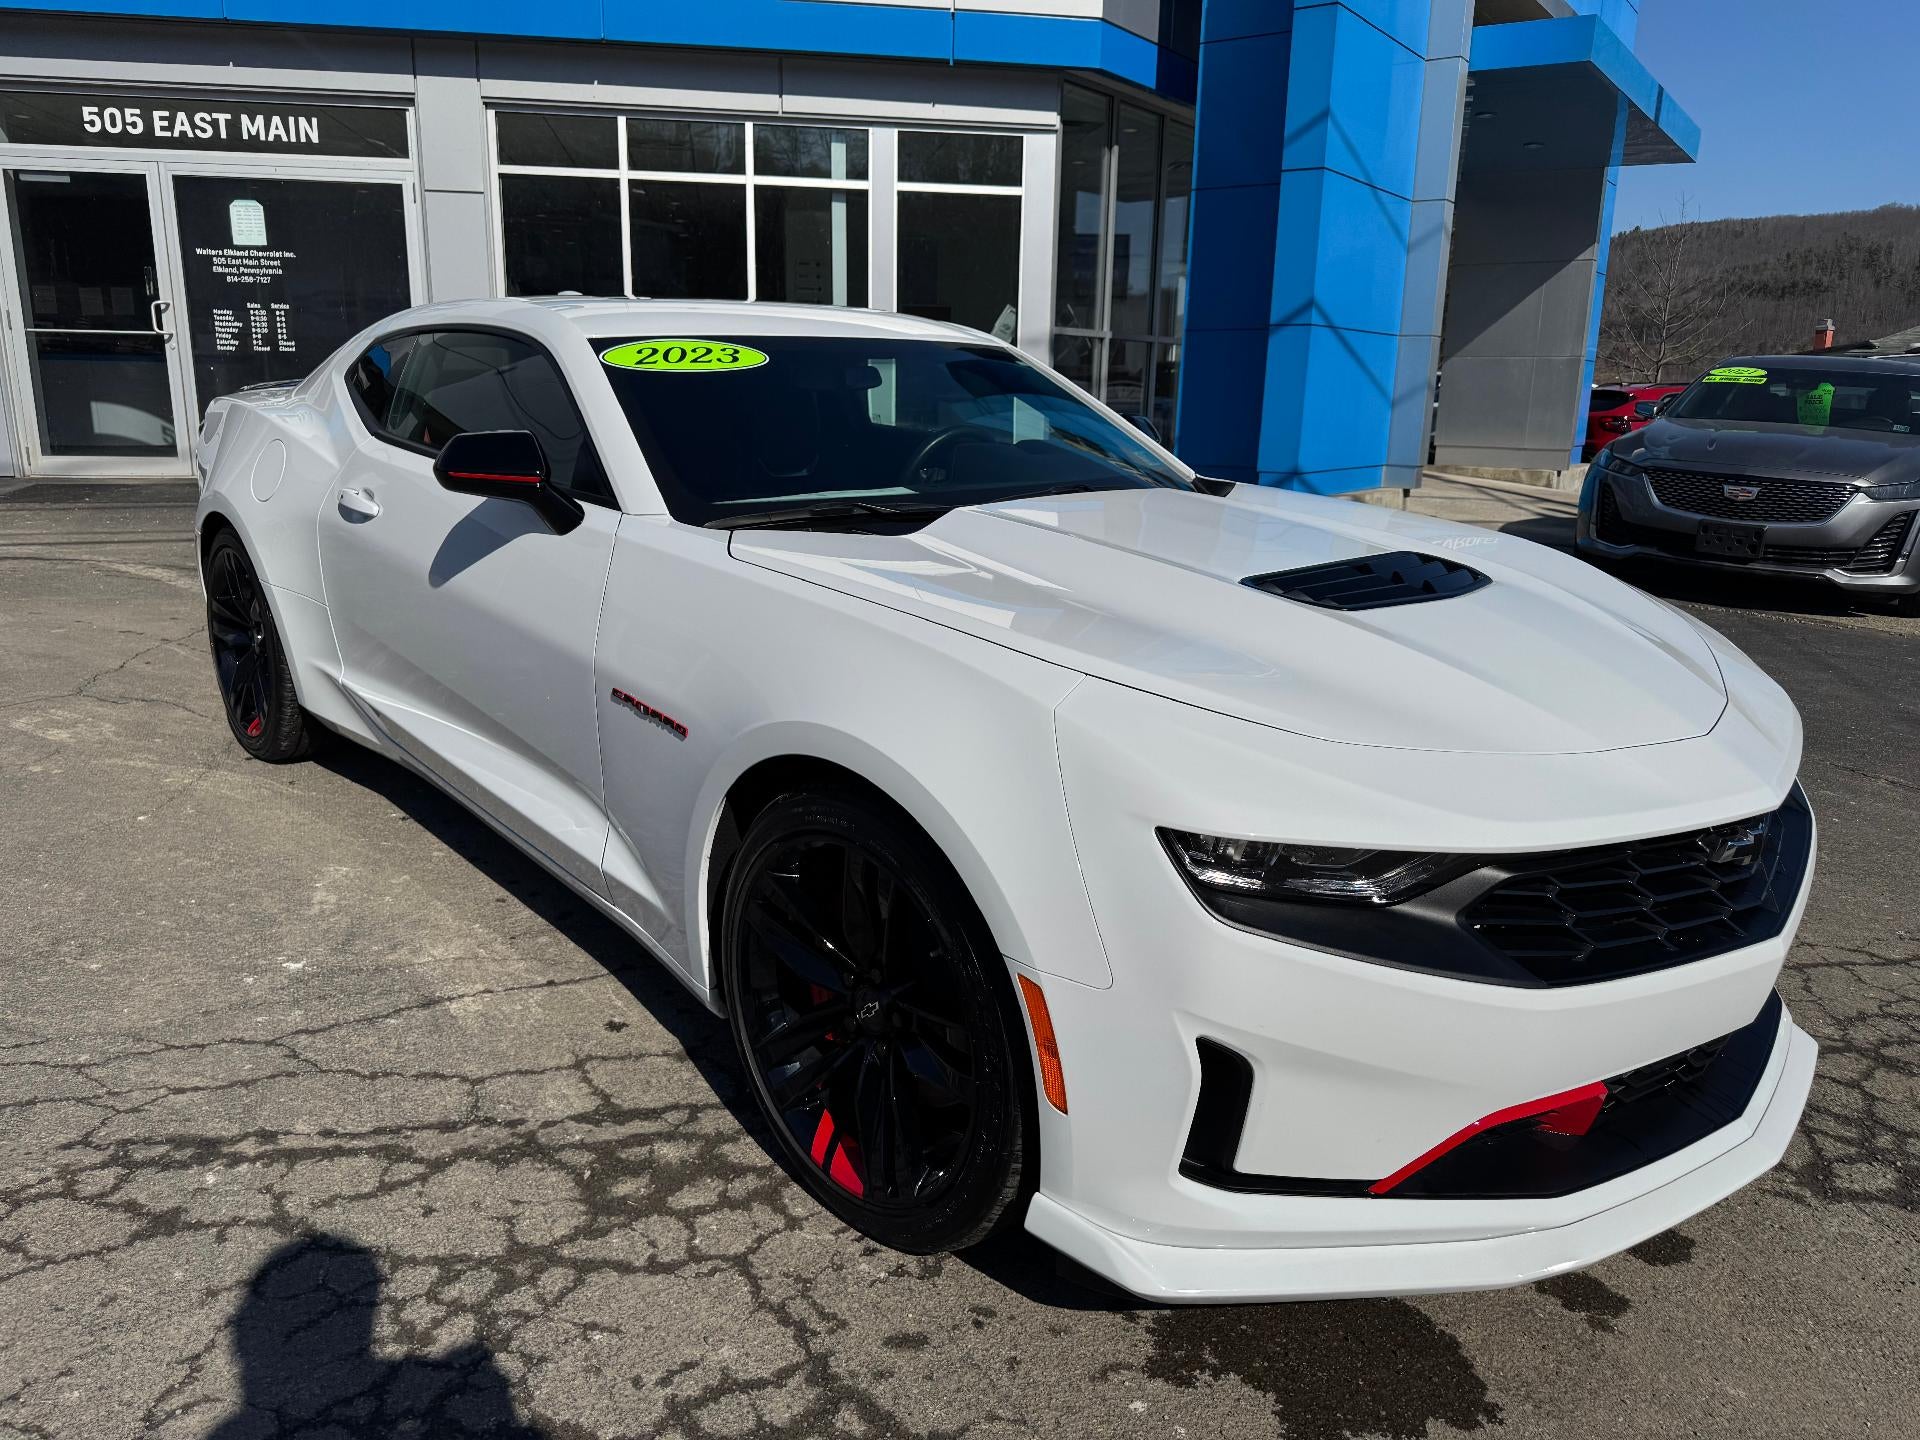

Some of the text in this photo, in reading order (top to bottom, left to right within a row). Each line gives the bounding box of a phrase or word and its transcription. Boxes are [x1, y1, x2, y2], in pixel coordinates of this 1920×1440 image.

[81, 106, 319, 144] 505 EAST MAIN
[195, 248, 297, 258] Walters Elkland Chevrolet Inc.
[212, 257, 281, 266] 505 East Main Street
[212, 265, 283, 276] Elkland, Pennsylvania
[226, 275, 271, 284] 814-258-7127
[634, 346, 741, 365] 2023
